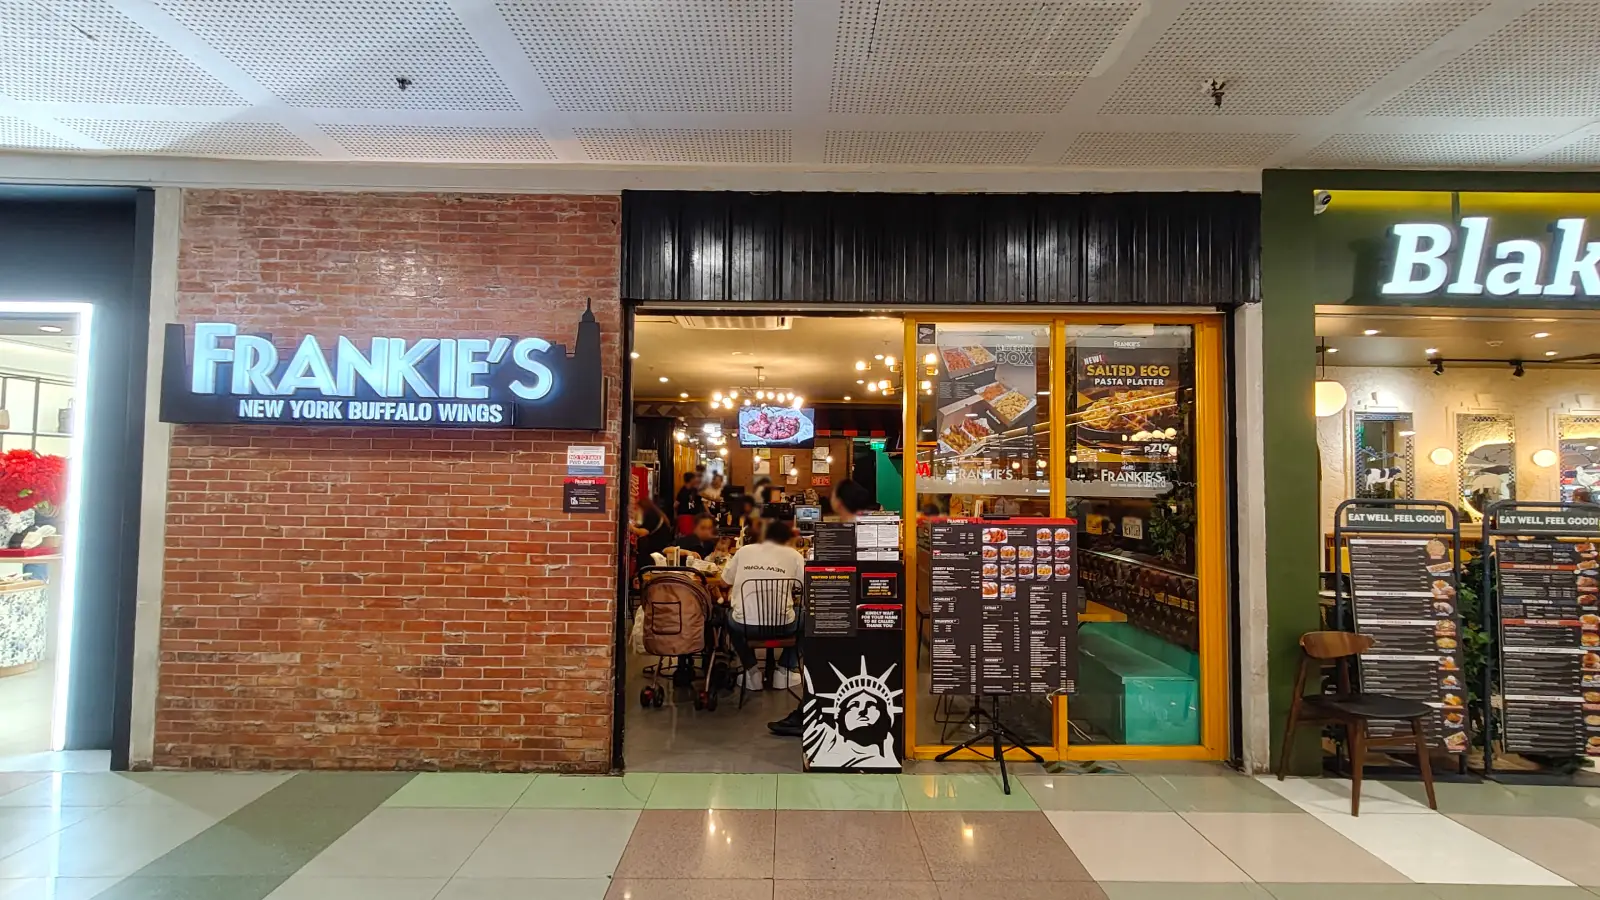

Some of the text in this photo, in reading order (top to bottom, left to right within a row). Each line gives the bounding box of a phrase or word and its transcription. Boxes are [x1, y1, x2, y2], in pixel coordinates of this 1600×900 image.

[1382, 217, 1600, 296] Blak
[191, 322, 553, 400] FRANKIE'S
[995, 351, 1034, 366] BOX
[1086, 365, 1170, 377] SALTED EGG
[1126, 378, 1164, 386] PLATTER
[239, 399, 503, 423] NEW YORK BUFFALO WINGS
[1101, 469, 1162, 483] FRANKIE'S
[1348, 513, 1445, 523] EAT WELL, FEEL GOOD!
[1500, 515, 1599, 525] EAT WELL, FEEL GOOD!
